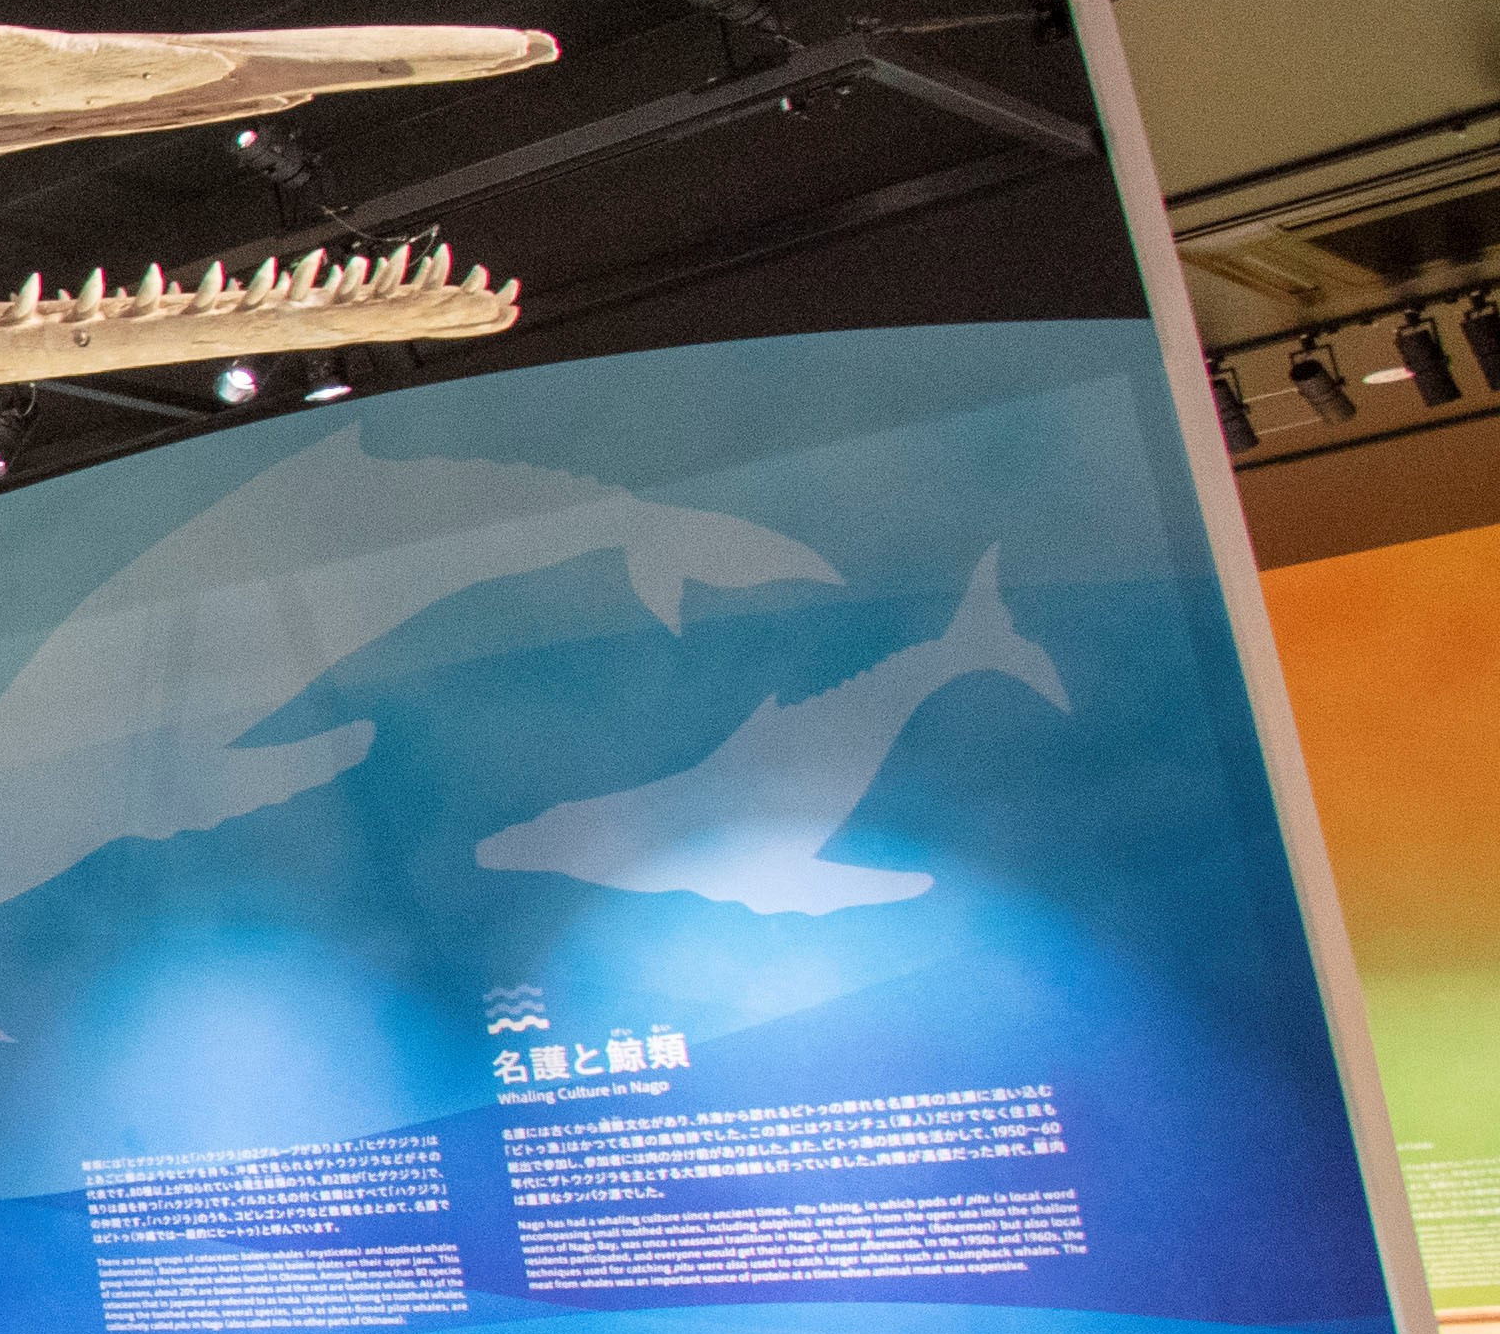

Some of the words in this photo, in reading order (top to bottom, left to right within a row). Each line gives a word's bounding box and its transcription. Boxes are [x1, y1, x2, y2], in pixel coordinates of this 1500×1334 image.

[493, 1032, 690, 1085] 名護と鯨類
[497, 1089, 556, 1105] Whaling
[558, 1085, 609, 1100] Culture
[612, 1083, 627, 1095] in
[630, 1079, 670, 1095] Nago
[514, 1184, 665, 1204] は重要なタンパク源でした。
[517, 1219, 545, 1231] Nago
[546, 1218, 564, 1228] has
[566, 1217, 586, 1227] had
[597, 1214, 639, 1227] whaling
[641, 1212, 680, 1223] culture
[681, 1210, 710, 1220] since
[712, 1208, 754, 1219] ancient
[879, 1199, 915, 1210] which
[917, 1197, 948, 1210] pods
[1009, 1192, 1041, 1203] local
[1043, 1190, 1077, 1201] word
[519, 1229, 591, 1243] encompassing
[592, 1228, 620, 1238] small
[621, 1225, 663, 1236] toothed
[705, 1220, 758, 1234] including
[758, 1217, 813, 1231] dolphins)
[814, 1218, 833, 1226] are
[835, 1214, 872, 1225] driven
[873, 1213, 902, 1223] from
[903, 1212, 924, 1222] the
[926, 1212, 957, 1223] open
[958, 1211, 979, 1219] sea
[980, 1207, 1006, 1218] into
[1007, 1206, 1029, 1216] the
[1030, 1203, 1080, 1215] shallow
[521, 1243, 554, 1253] waters
[568, 1241, 596, 1253] Nago
[620, 1241, 641, 1249] was
[642, 1240, 668, 1248] once
[678, 1235, 724, 1246] seasonal
[725, 1232, 773, 1244] tradition
[822, 1229, 845, 1239] Not
[846, 1227, 874, 1240] only
[928, 1221, 999, 1236] (fishermen)
[999, 1220, 1022, 1230] but
[1023, 1219, 1049, 1229] also
[1050, 1217, 1081, 1228] local
[523, 1255, 567, 1265] residents
[633, 1251, 652, 1260] and
[655, 1251, 701, 1262] everyone
[703, 1247, 736, 1257] would
[738, 1246, 755, 1258] get
[757, 1245, 782, 1255] their
[784, 1243, 814, 1254] share
[830, 1241, 858, 1251] meat
[939, 1236, 960, 1246] the
[962, 1235, 996, 1245] 1950s
[998, 1233, 1022, 1244] and
[1063, 1230, 1084, 1241] the
[525, 1267, 582, 1280] techniques
[582, 1265, 608, 1275] used
[608, 1265, 625, 1274] for
[625, 1263, 672, 1276] catching
[696, 1262, 724, 1270] were
[725, 1259, 748, 1269] also
[749, 1258, 777, 1268] used
[792, 1256, 823, 1266] catch
[824, 1254, 860, 1267] larger
[860, 1252, 902, 1263] whales
[902, 1251, 931, 1261] such
[947, 1247, 1013, 1262] humpback
[1062, 1244, 1088, 1255] The
[528, 1280, 554, 1290] meat
[554, 1279, 578, 1289] from
[579, 1278, 614, 1288] whales
[650, 1274, 702, 1287] important
[702, 1275, 737, 1283] source
[750, 1270, 791, 1283] protein
[812, 1268, 839, 1278] time
[839, 1267, 871, 1277] when
[872, 1265, 911, 1276] animal
[912, 1264, 942, 1274] meat
[943, 1265, 966, 1273] was
